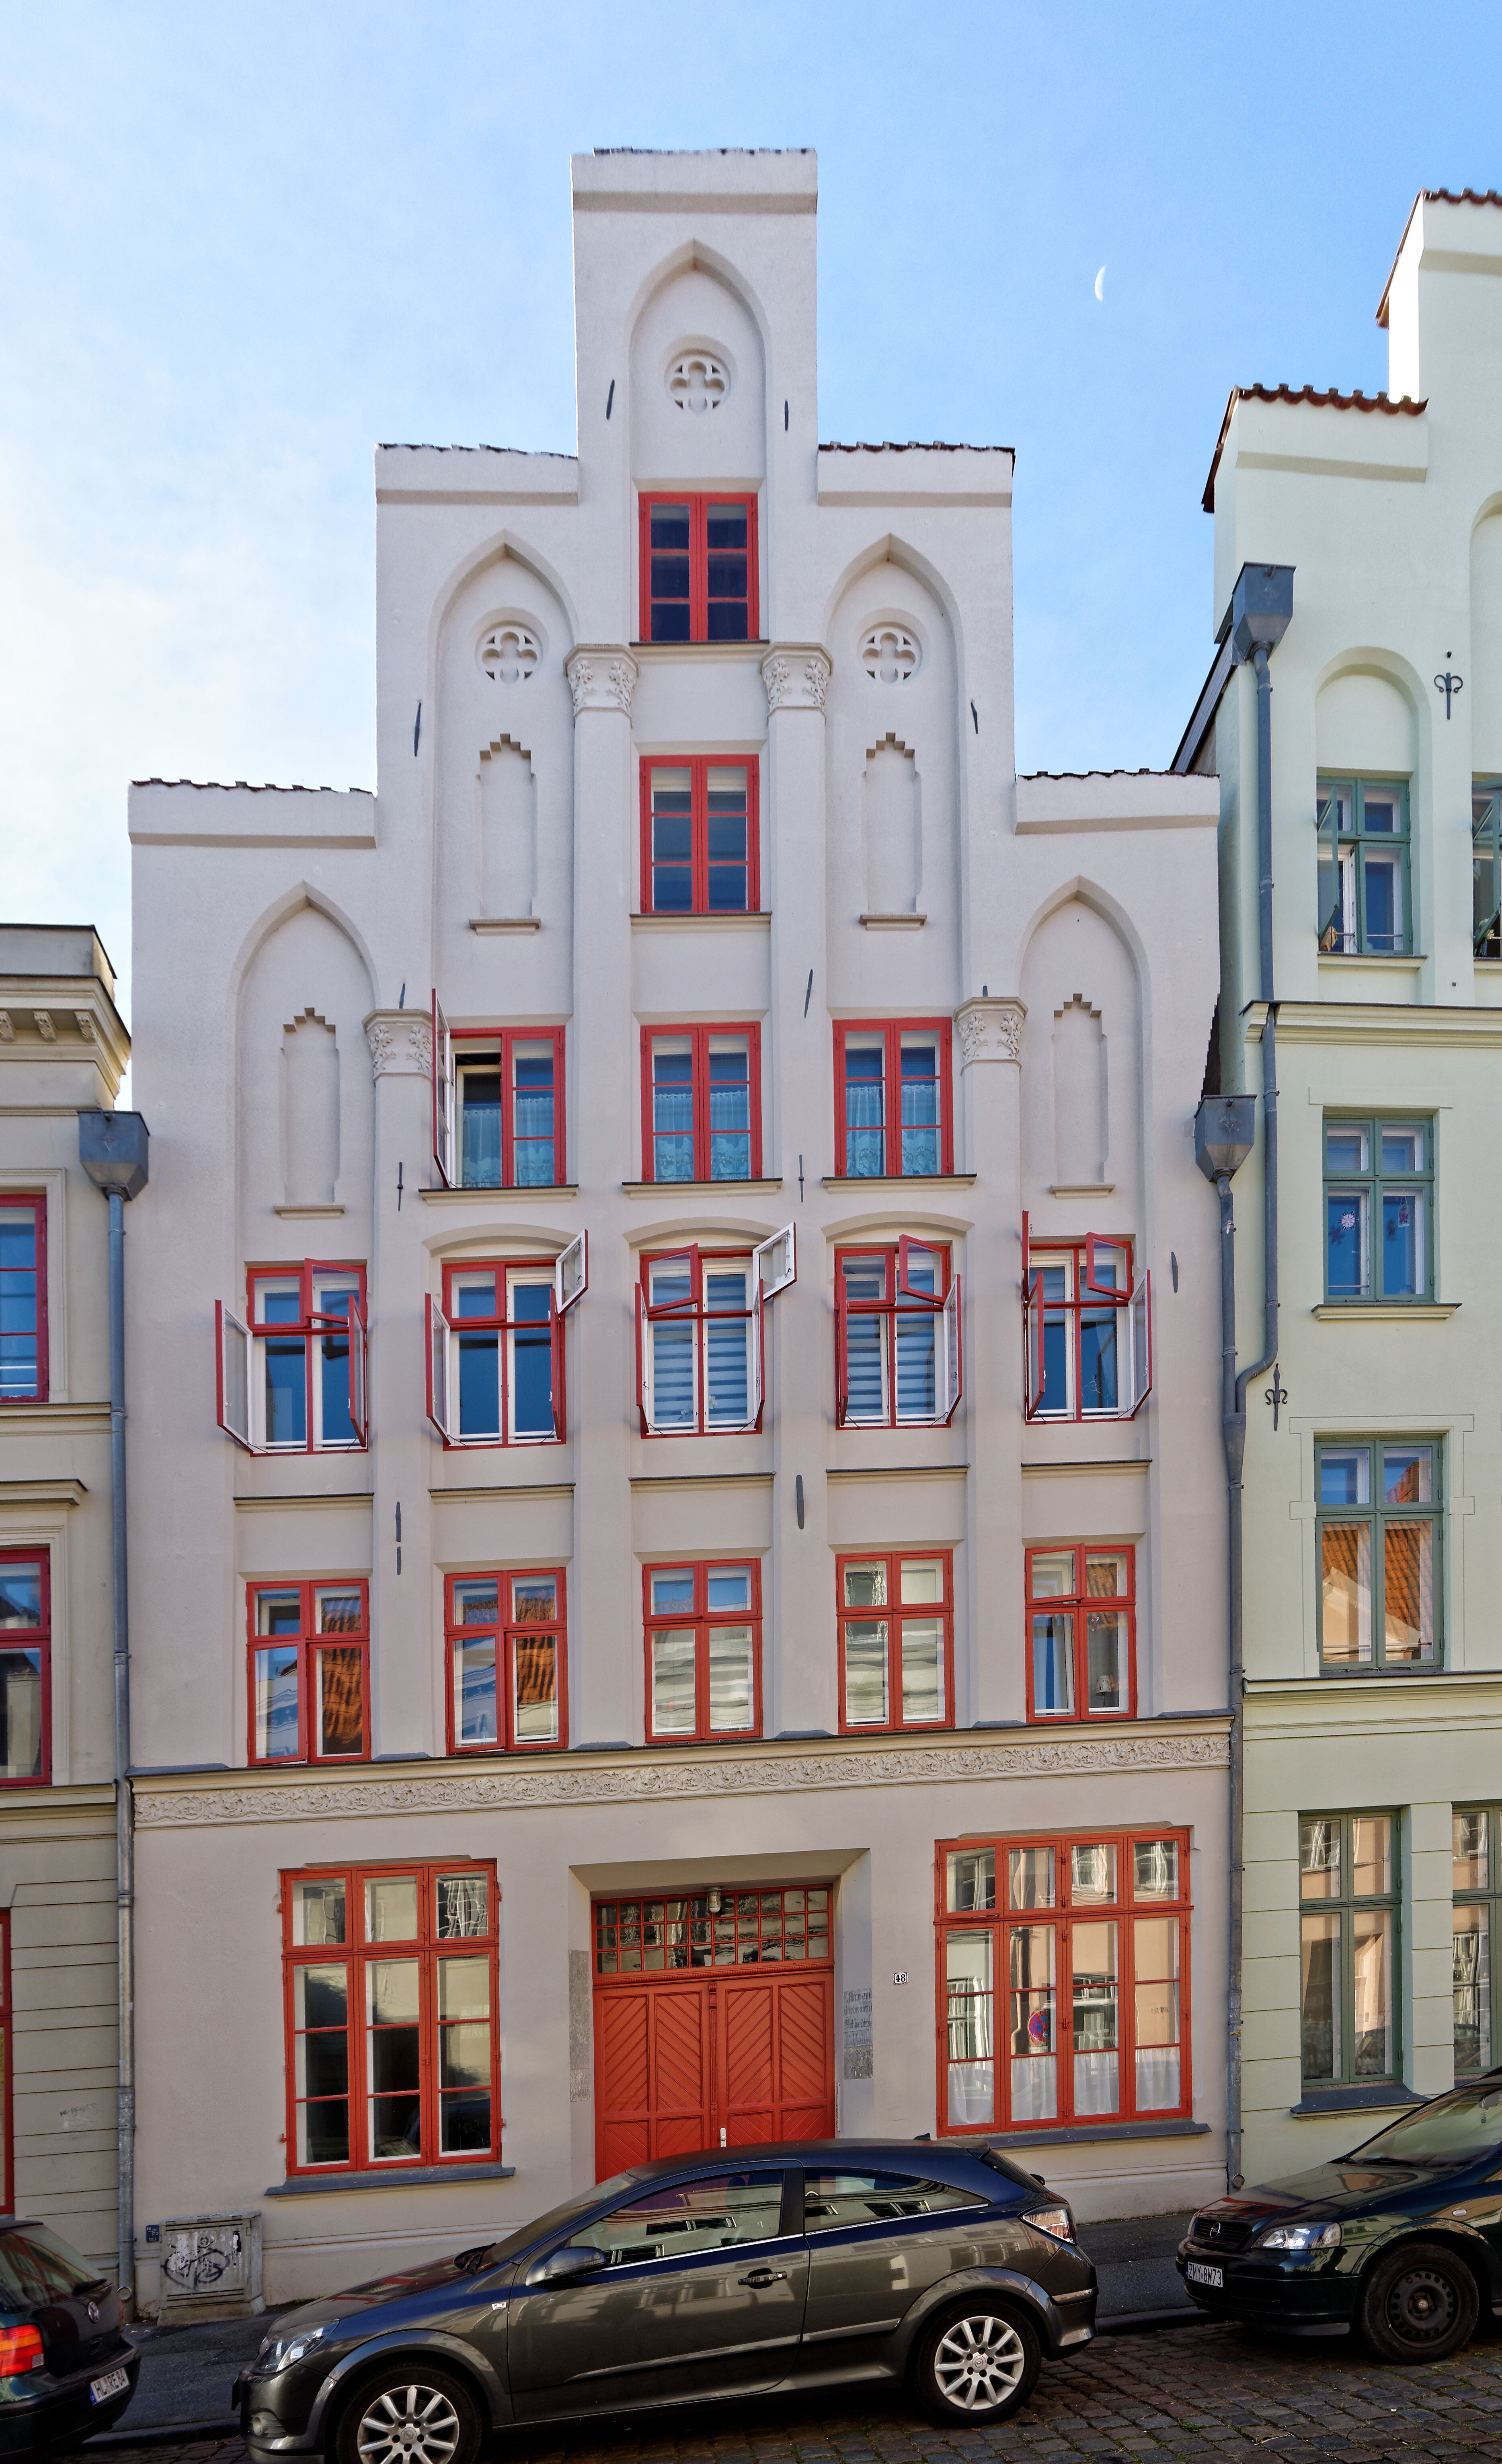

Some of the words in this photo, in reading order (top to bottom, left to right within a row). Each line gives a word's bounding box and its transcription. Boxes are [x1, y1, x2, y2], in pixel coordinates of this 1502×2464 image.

[895, 1974, 906, 1983] 48
[1188, 2263, 1201, 2281] ZMY
[1204, 2267, 1221, 2286] 8W73
[93, 2381, 107, 2398] HL
[107, 2373, 119, 2391] RE
